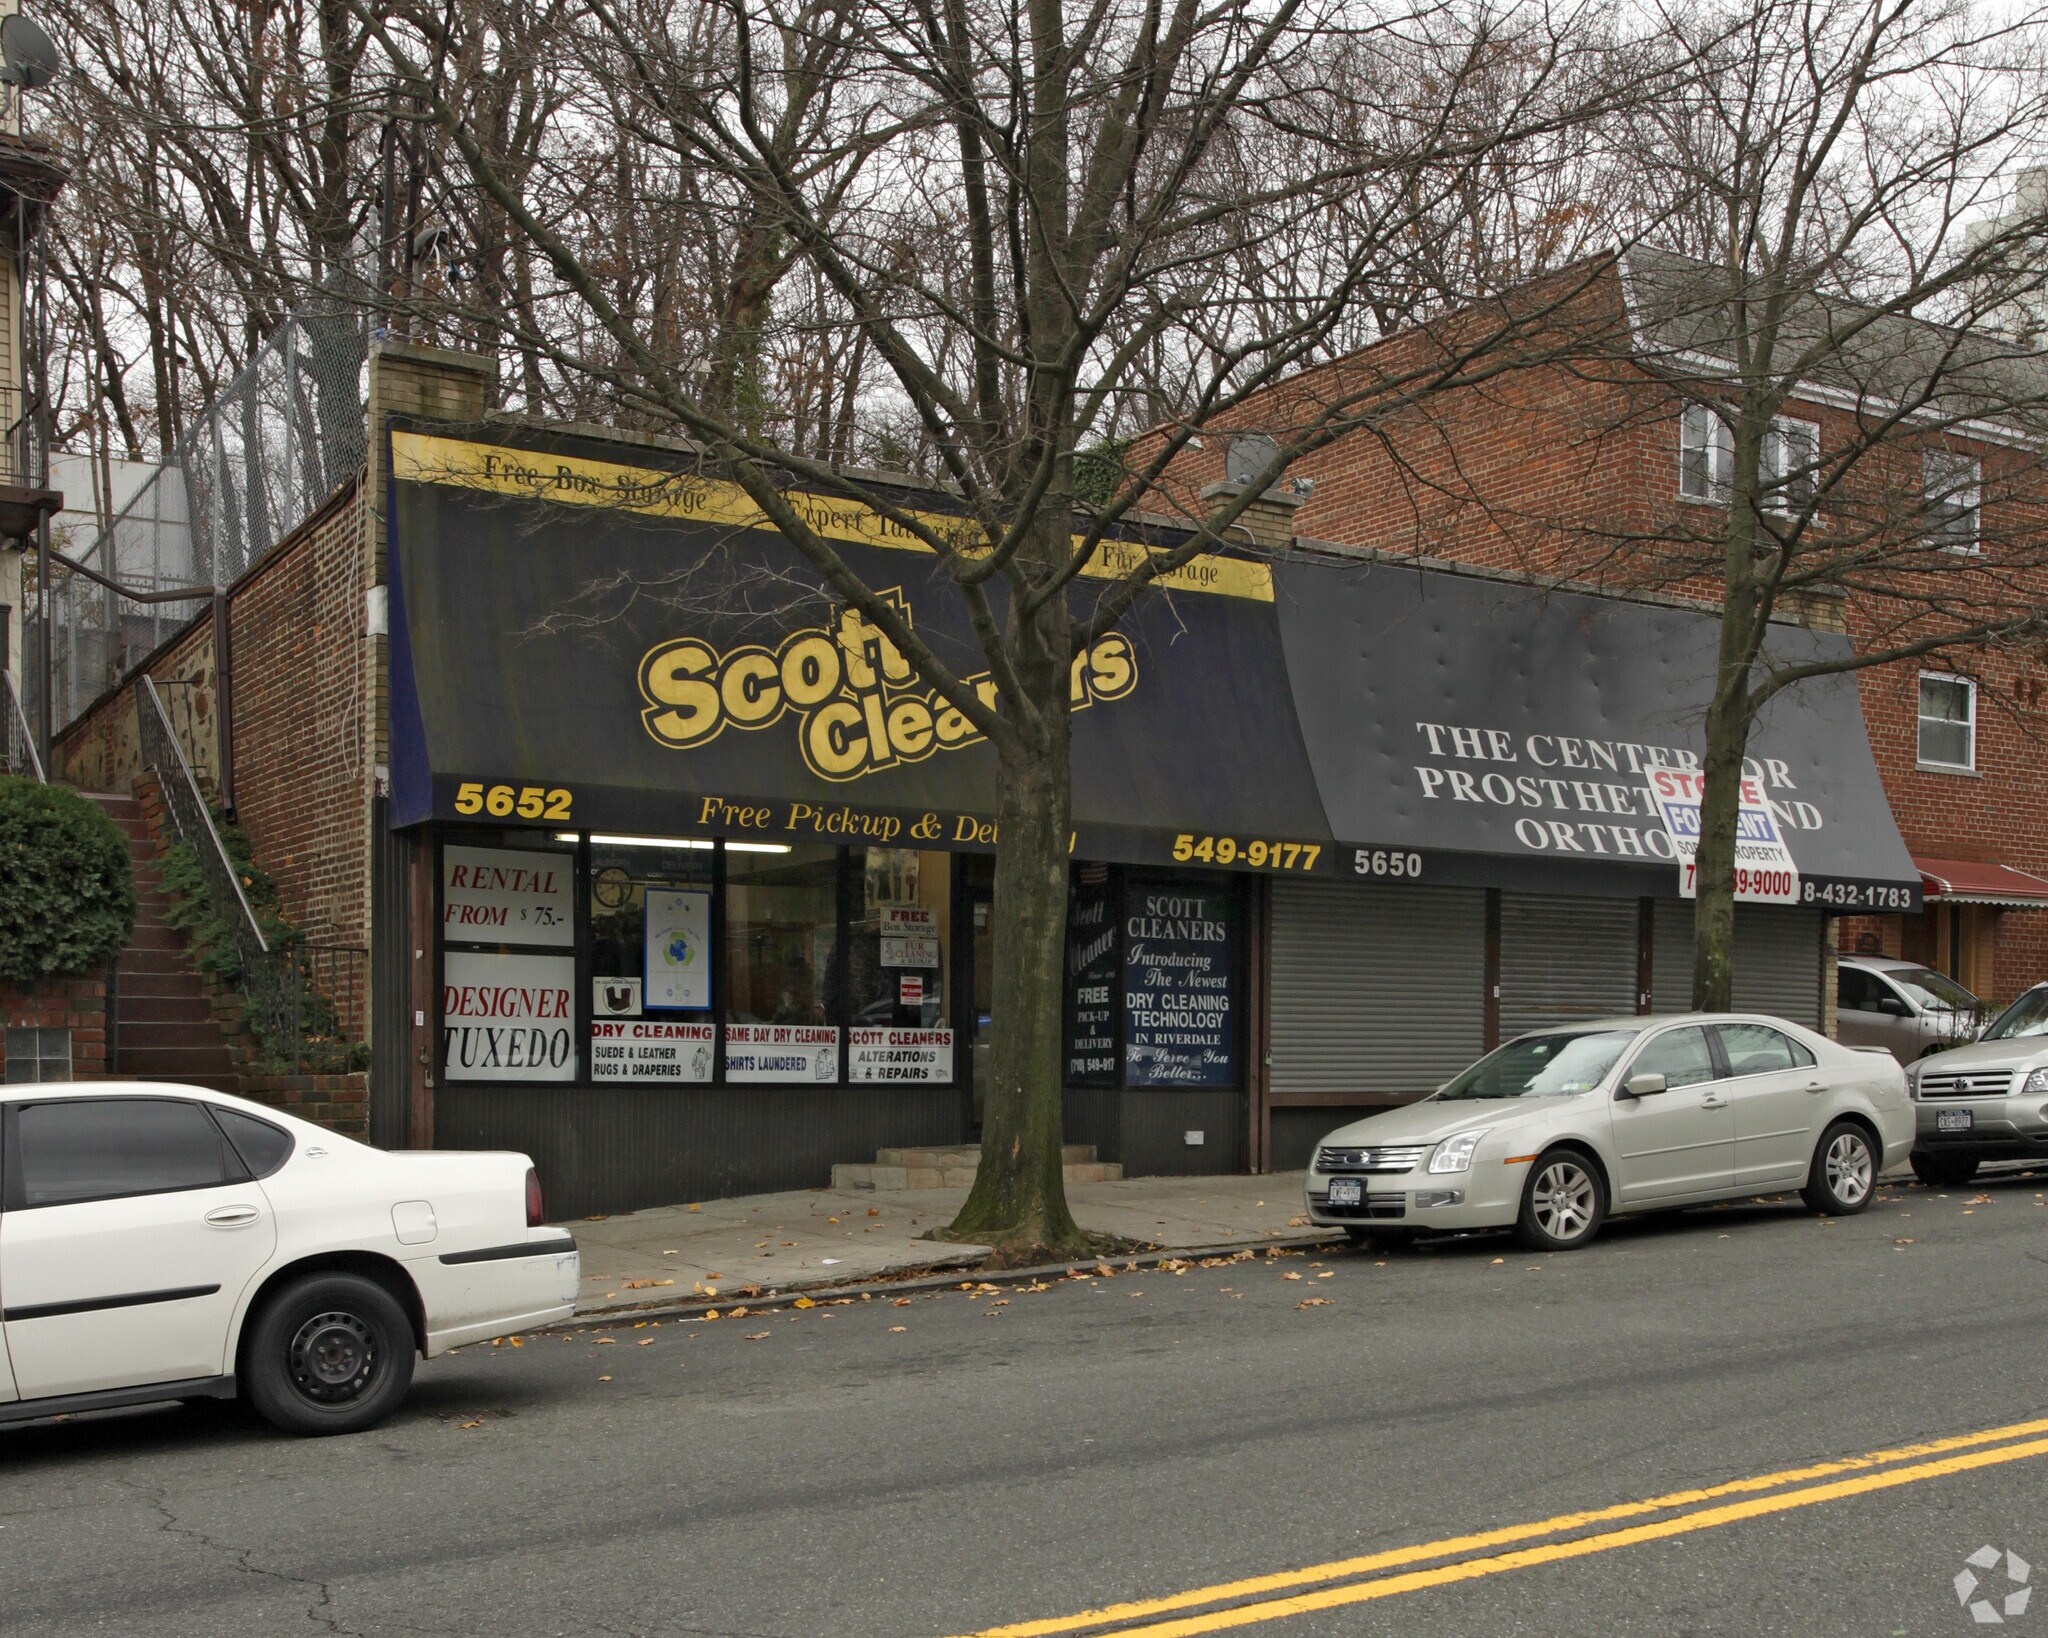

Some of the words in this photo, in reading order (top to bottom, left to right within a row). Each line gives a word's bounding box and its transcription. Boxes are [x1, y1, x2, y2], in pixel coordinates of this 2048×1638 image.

[483, 454, 538, 486] Free
[555, 464, 601, 494] Box
[798, 632, 1138, 782] Clears
[1416, 722, 1518, 762] THE
[1526, 734, 1704, 775] CENTER
[1740, 756, 1798, 789] OR
[1655, 771, 1762, 805] STE
[454, 782, 573, 820] 5652
[1413, 766, 1662, 818] PROSTHET
[1768, 799, 1823, 830] ND
[697, 796, 772, 829] Free
[785, 802, 902, 843] Pickup
[911, 813, 943, 840] &
[1667, 806, 1701, 835] FO
[1737, 811, 1770, 840] ENT
[1514, 818, 1677, 859] ORTHO
[1172, 833, 1321, 872] 549-9177
[1735, 846, 1785, 863] ROPERTY
[1354, 849, 1422, 878] 5650
[450, 863, 559, 895] RENTAL
[1803, 881, 1911, 909] 8-432-1783
[444, 903, 510, 926] FROM
[520, 907, 528, 921] $
[891, 910, 929, 922] FREE
[1146, 895, 1206, 919] SCOTT
[884, 922, 901, 932] Box
[904, 922, 936, 934] Storage
[1127, 916, 1226, 942] CLEANERS
[895, 949, 936, 960] CLEANING
[905, 941, 924, 951] FUR
[1127, 943, 1212, 971] Introducing
[1143, 967, 1174, 988] The
[1177, 969, 1227, 989] Newest
[444, 985, 571, 1019] DESIGNER
[1077, 986, 1110, 1005] FREE
[1127, 992, 1154, 1009] DRY
[1161, 993, 1229, 1011] CLEANING
[1077, 1010, 1110, 1023] PICK-UP
[1132, 1010, 1223, 1028] TECHNOLOGY
[592, 1023, 625, 1038] DRY
[632, 1024, 713, 1040] CLEANING
[725, 1027, 750, 1042] SAME
[754, 1028, 771, 1042] DAY
[774, 1029, 791, 1043] DRY
[795, 1029, 836, 1044] CLEANING
[848, 1031, 883, 1046] SCOTT
[889, 1031, 951, 1046] CLEANERS
[1090, 1024, 1097, 1036] &
[1135, 1033, 1149, 1044] IN
[1154, 1033, 1221, 1046] RIVERDALE
[443, 1026, 571, 1069] TUXEDO
[1074, 1037, 1114, 1050] DELIVERY
[595, 1047, 625, 1060] SUEDE
[628, 1048, 635, 1060] &
[638, 1048, 677, 1060] LEATHER
[725, 1055, 755, 1070] SHIRTS
[758, 1056, 807, 1071] LAUNDERED
[858, 1050, 936, 1063] ALTERATIONS
[1126, 1048, 1143, 1063] To
[1152, 1048, 1189, 1064] Serve
[1202, 1048, 1229, 1065] You
[594, 1064, 619, 1076] RUGS
[622, 1065, 629, 1077] &
[632, 1065, 682, 1077] DRAPERIES
[865, 1067, 872, 1079] &
[878, 1067, 929, 1080] REPAIRS
[1148, 1063, 1207, 1080] Better...
